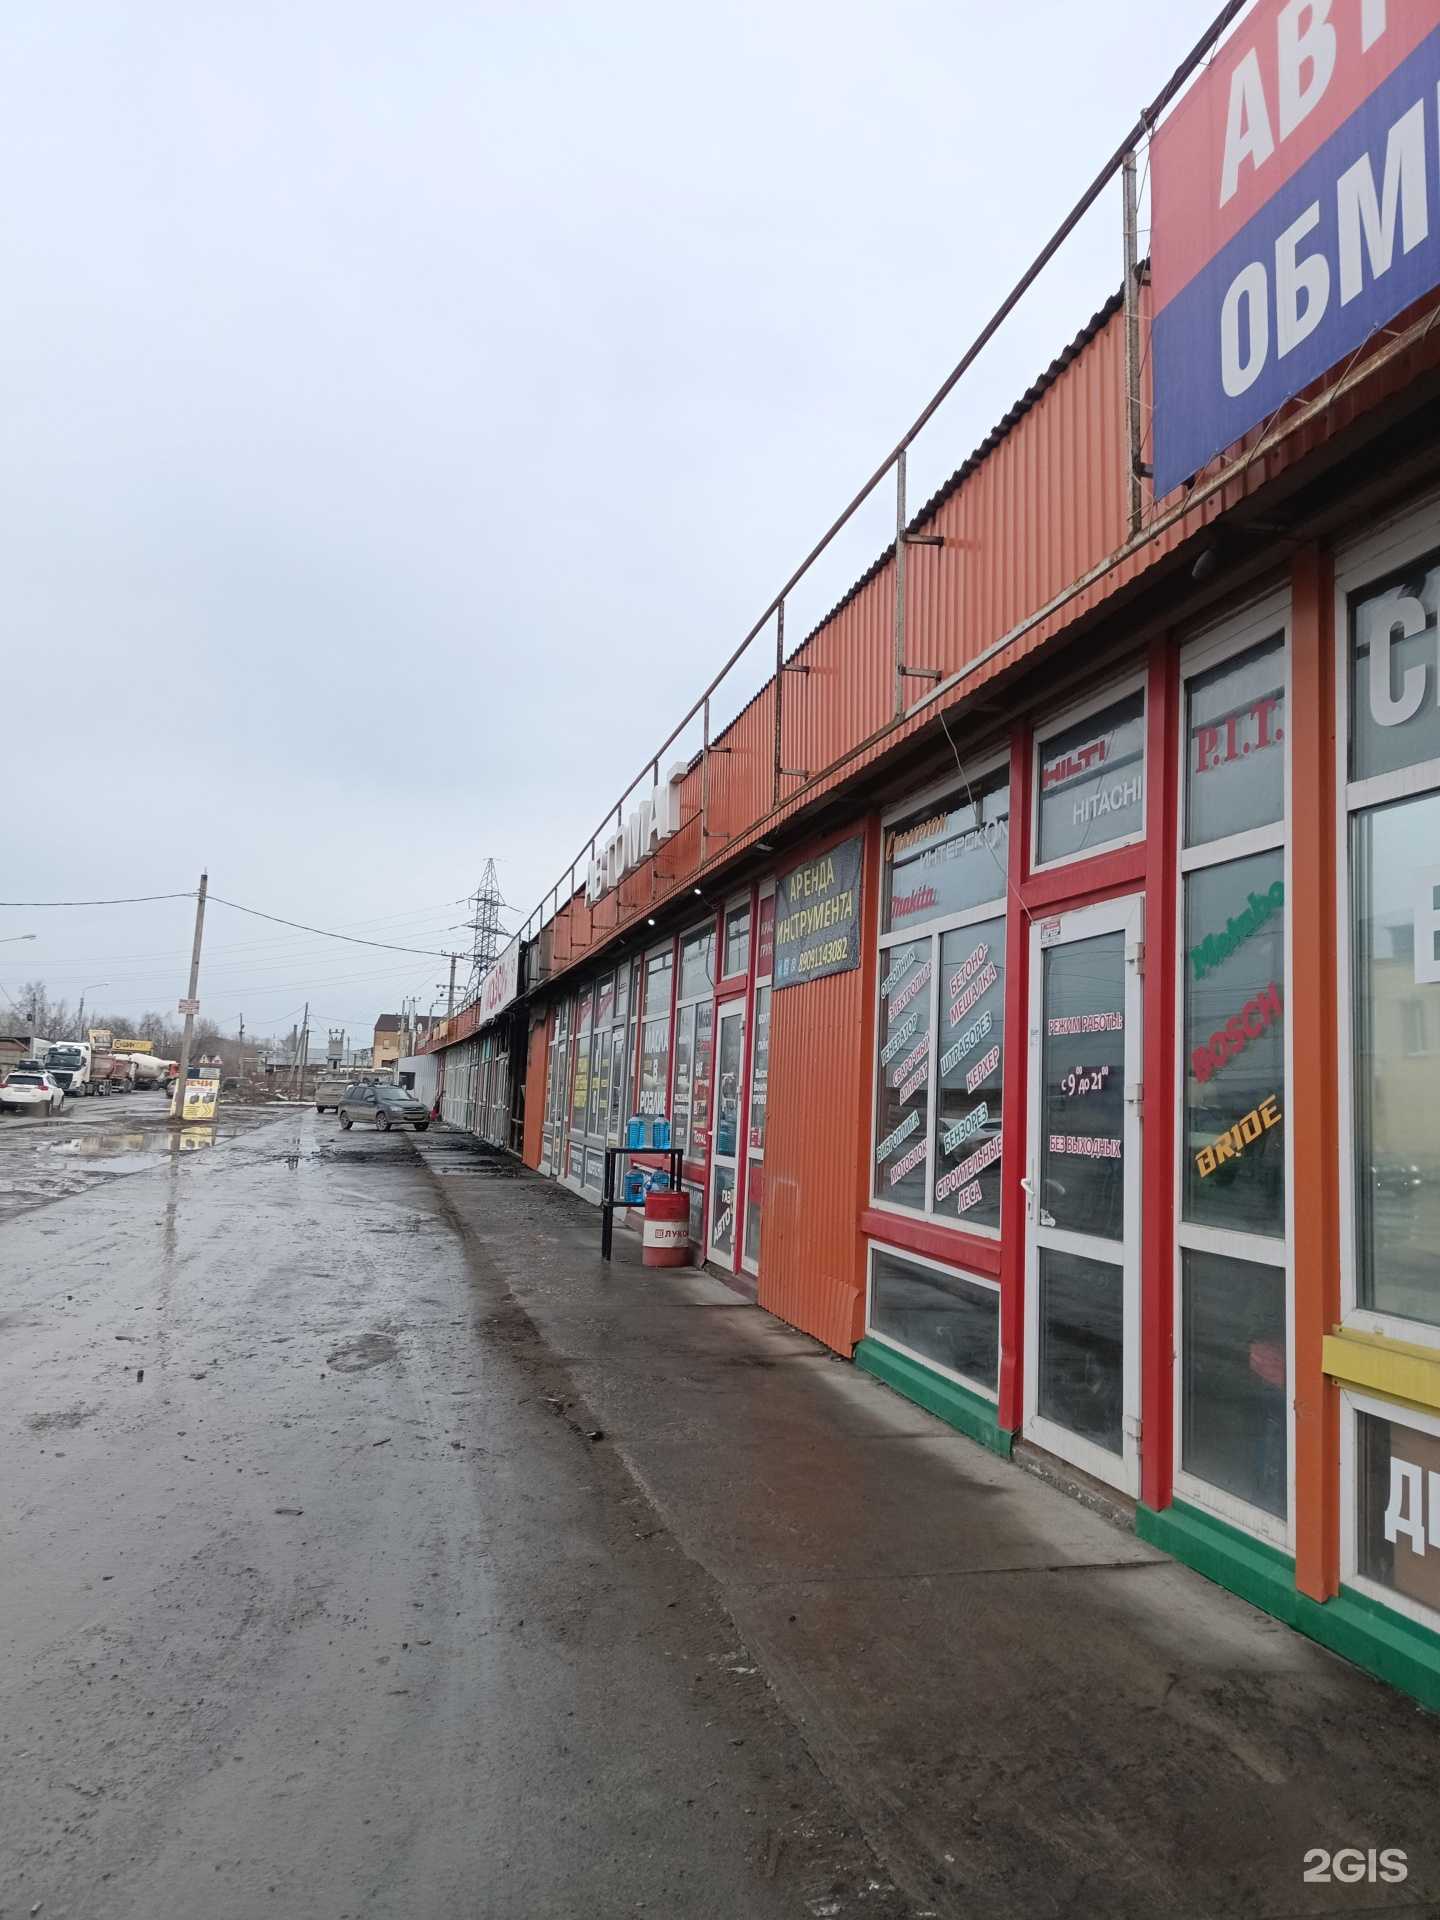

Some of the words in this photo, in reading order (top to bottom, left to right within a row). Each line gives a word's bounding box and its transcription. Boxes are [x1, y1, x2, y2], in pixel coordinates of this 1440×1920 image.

[1219, 0, 1386, 208] АВ
[1221, 82, 1440, 397] ОБМ
[1369, 595, 1440, 726] С
[1196, 697, 1284, 774] P.I.T.
[1042, 739, 1105, 789] HILTI
[1073, 776, 1142, 825] HITACHI
[585, 762, 688, 908] АВТОМАГ
[789, 857, 835, 903] АРЕНДА
[776, 890, 853, 945] ИНСТРУМЕНТА
[950, 943, 988, 998] БЕТОНО-
[950, 961, 997, 1027] МЕШАЛКА
[881, 1010, 919, 1067] ГЕНЕРАТОР
[940, 1010, 992, 1077] ШТРАБОРЕЗ
[1048, 1016, 1080, 1036] РЕЖИМ
[1081, 1012, 1123, 1033] РАБОТЫ:
[1191, 980, 1283, 1084] BOSCH
[900, 1061, 928, 1106] АППАРАТ
[966, 1045, 999, 1094] КЕРХЕР
[1078, 1079, 1090, 1095] до
[876, 1110, 920, 1164] ВИБРОПЛИТА
[944, 1102, 988, 1155] БЕНЗОРЕЗ
[1050, 1135, 1066, 1152] БЕЗ
[1067, 1137, 1121, 1158] ВЫХОДНЫХ
[1195, 1094, 1282, 1179] BRIDE
[936, 1135, 1002, 1201] СТРОИТЕЛЬНЫЕ
[958, 1180, 982, 1214] ЛЕСА
